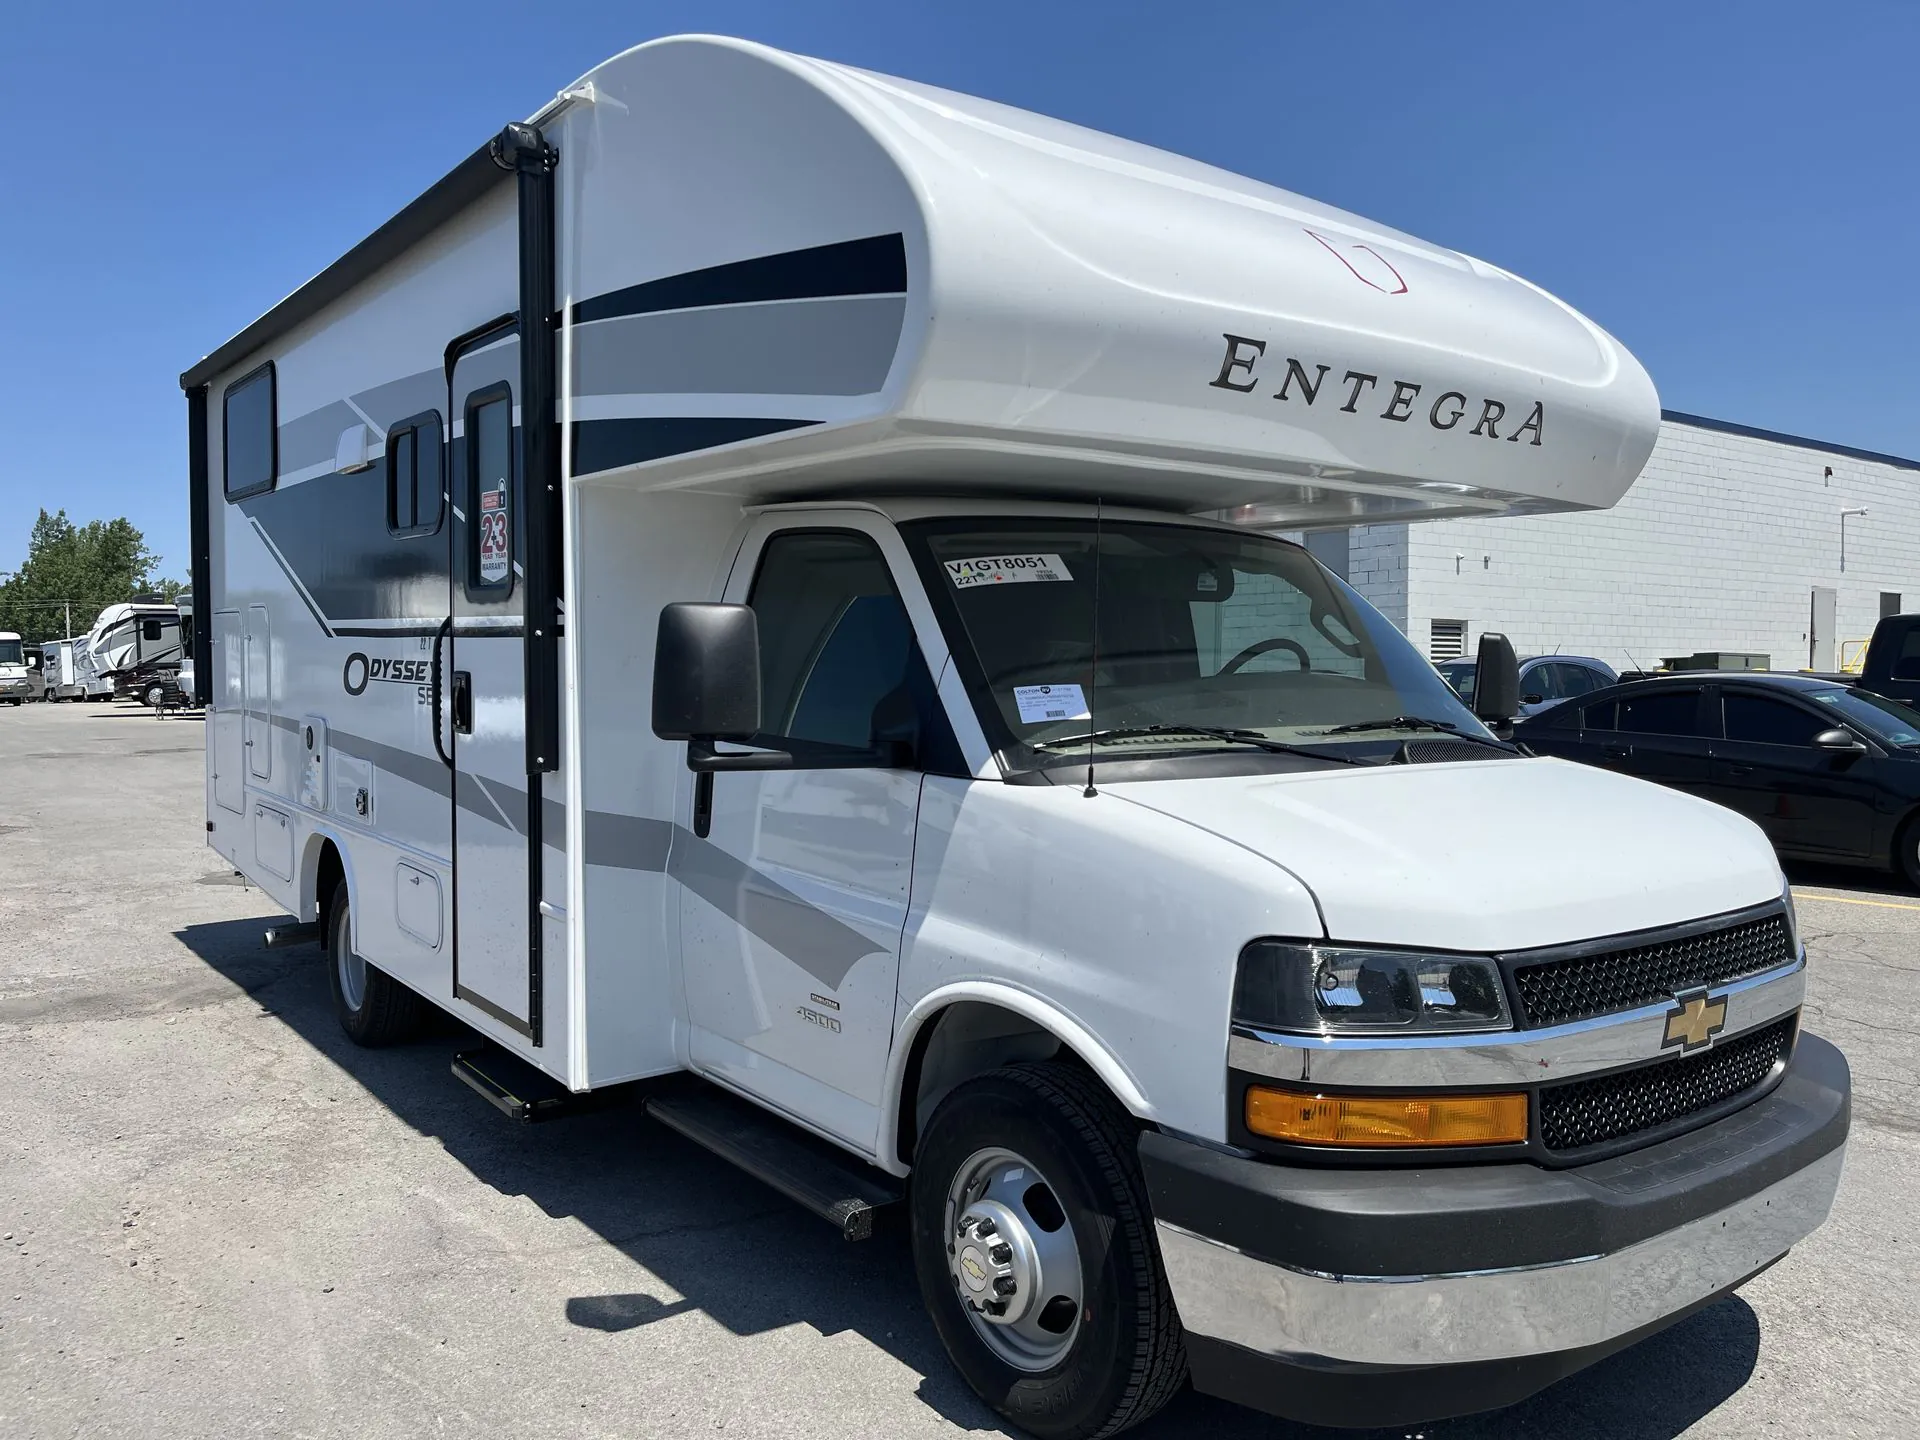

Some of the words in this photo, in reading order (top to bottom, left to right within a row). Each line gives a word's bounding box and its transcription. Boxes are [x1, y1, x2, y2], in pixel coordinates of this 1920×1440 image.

[1209, 333, 1543, 446] ENTEGRA
[482, 562, 506, 571] WARRANTY
[947, 557, 1047, 574] V1GT8051
